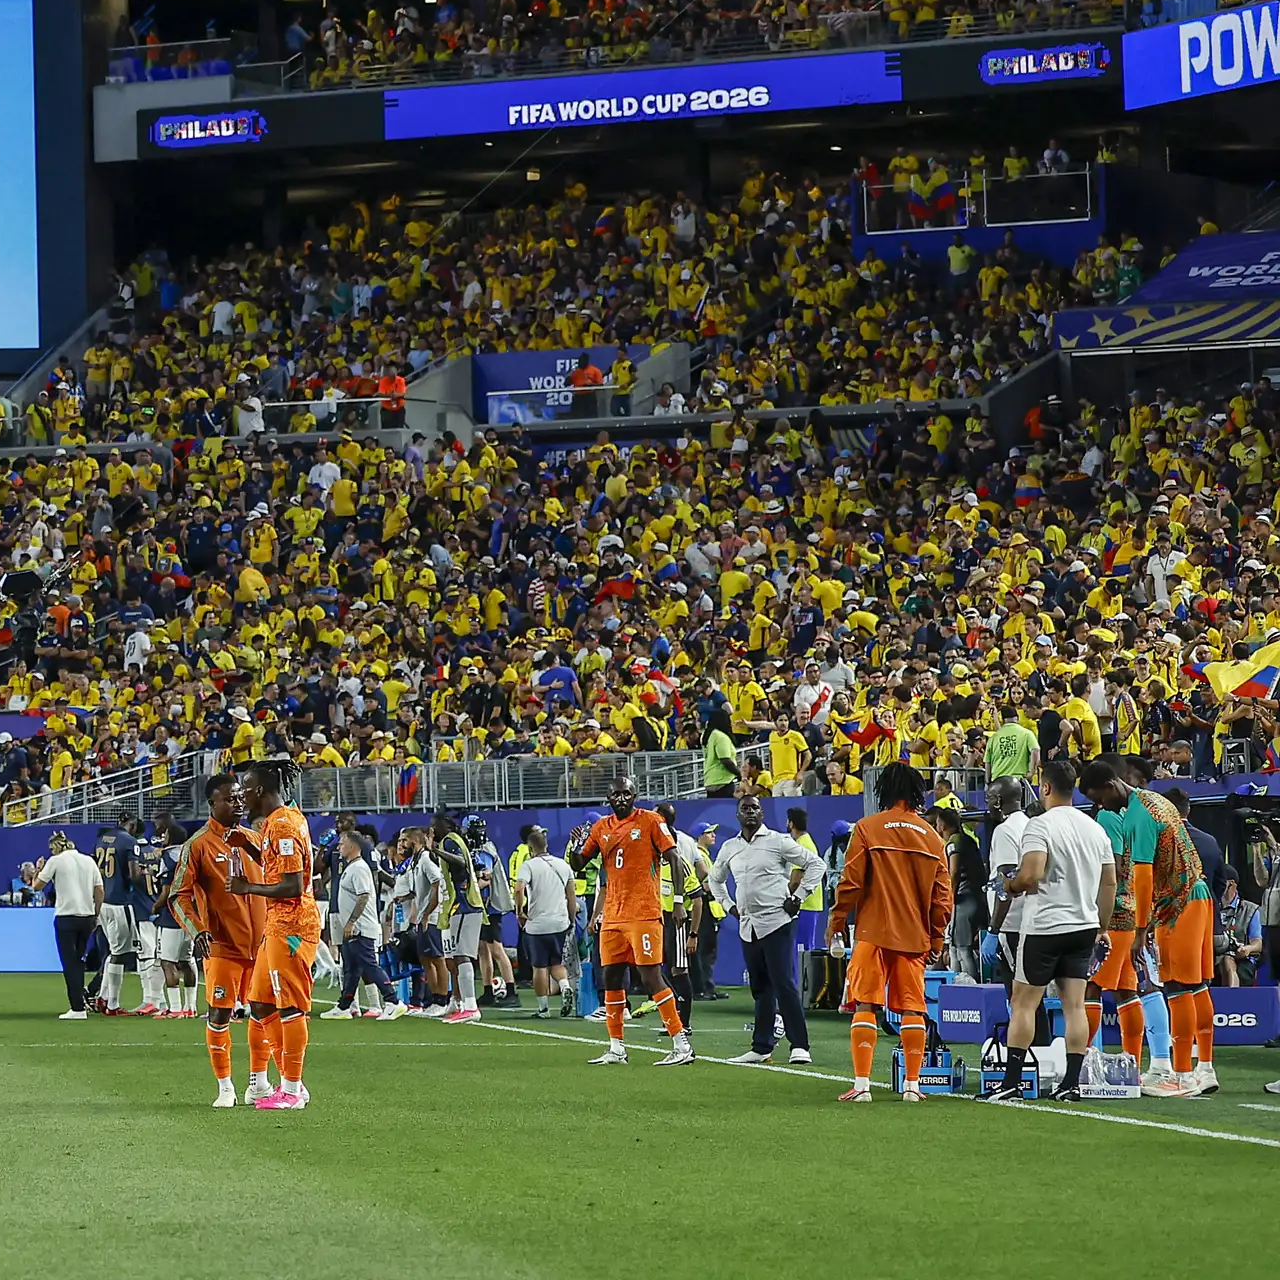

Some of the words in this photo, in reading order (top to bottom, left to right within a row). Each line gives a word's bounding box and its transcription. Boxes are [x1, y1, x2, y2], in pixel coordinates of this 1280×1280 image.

[508, 101, 557, 125] FIFA
[558, 96, 639, 121] WORLD
[641, 92, 686, 115] CUP
[689, 86, 770, 111] 2026
[546, 391, 573, 406] 20
[999, 734, 1017, 744] CSC
[95, 846, 116, 879] 25
[615, 848, 624, 869] 6
[641, 933, 652, 951] 6
[1213, 1013, 1257, 1027] 026
[1081, 1083, 1128, 1096] smartwater
